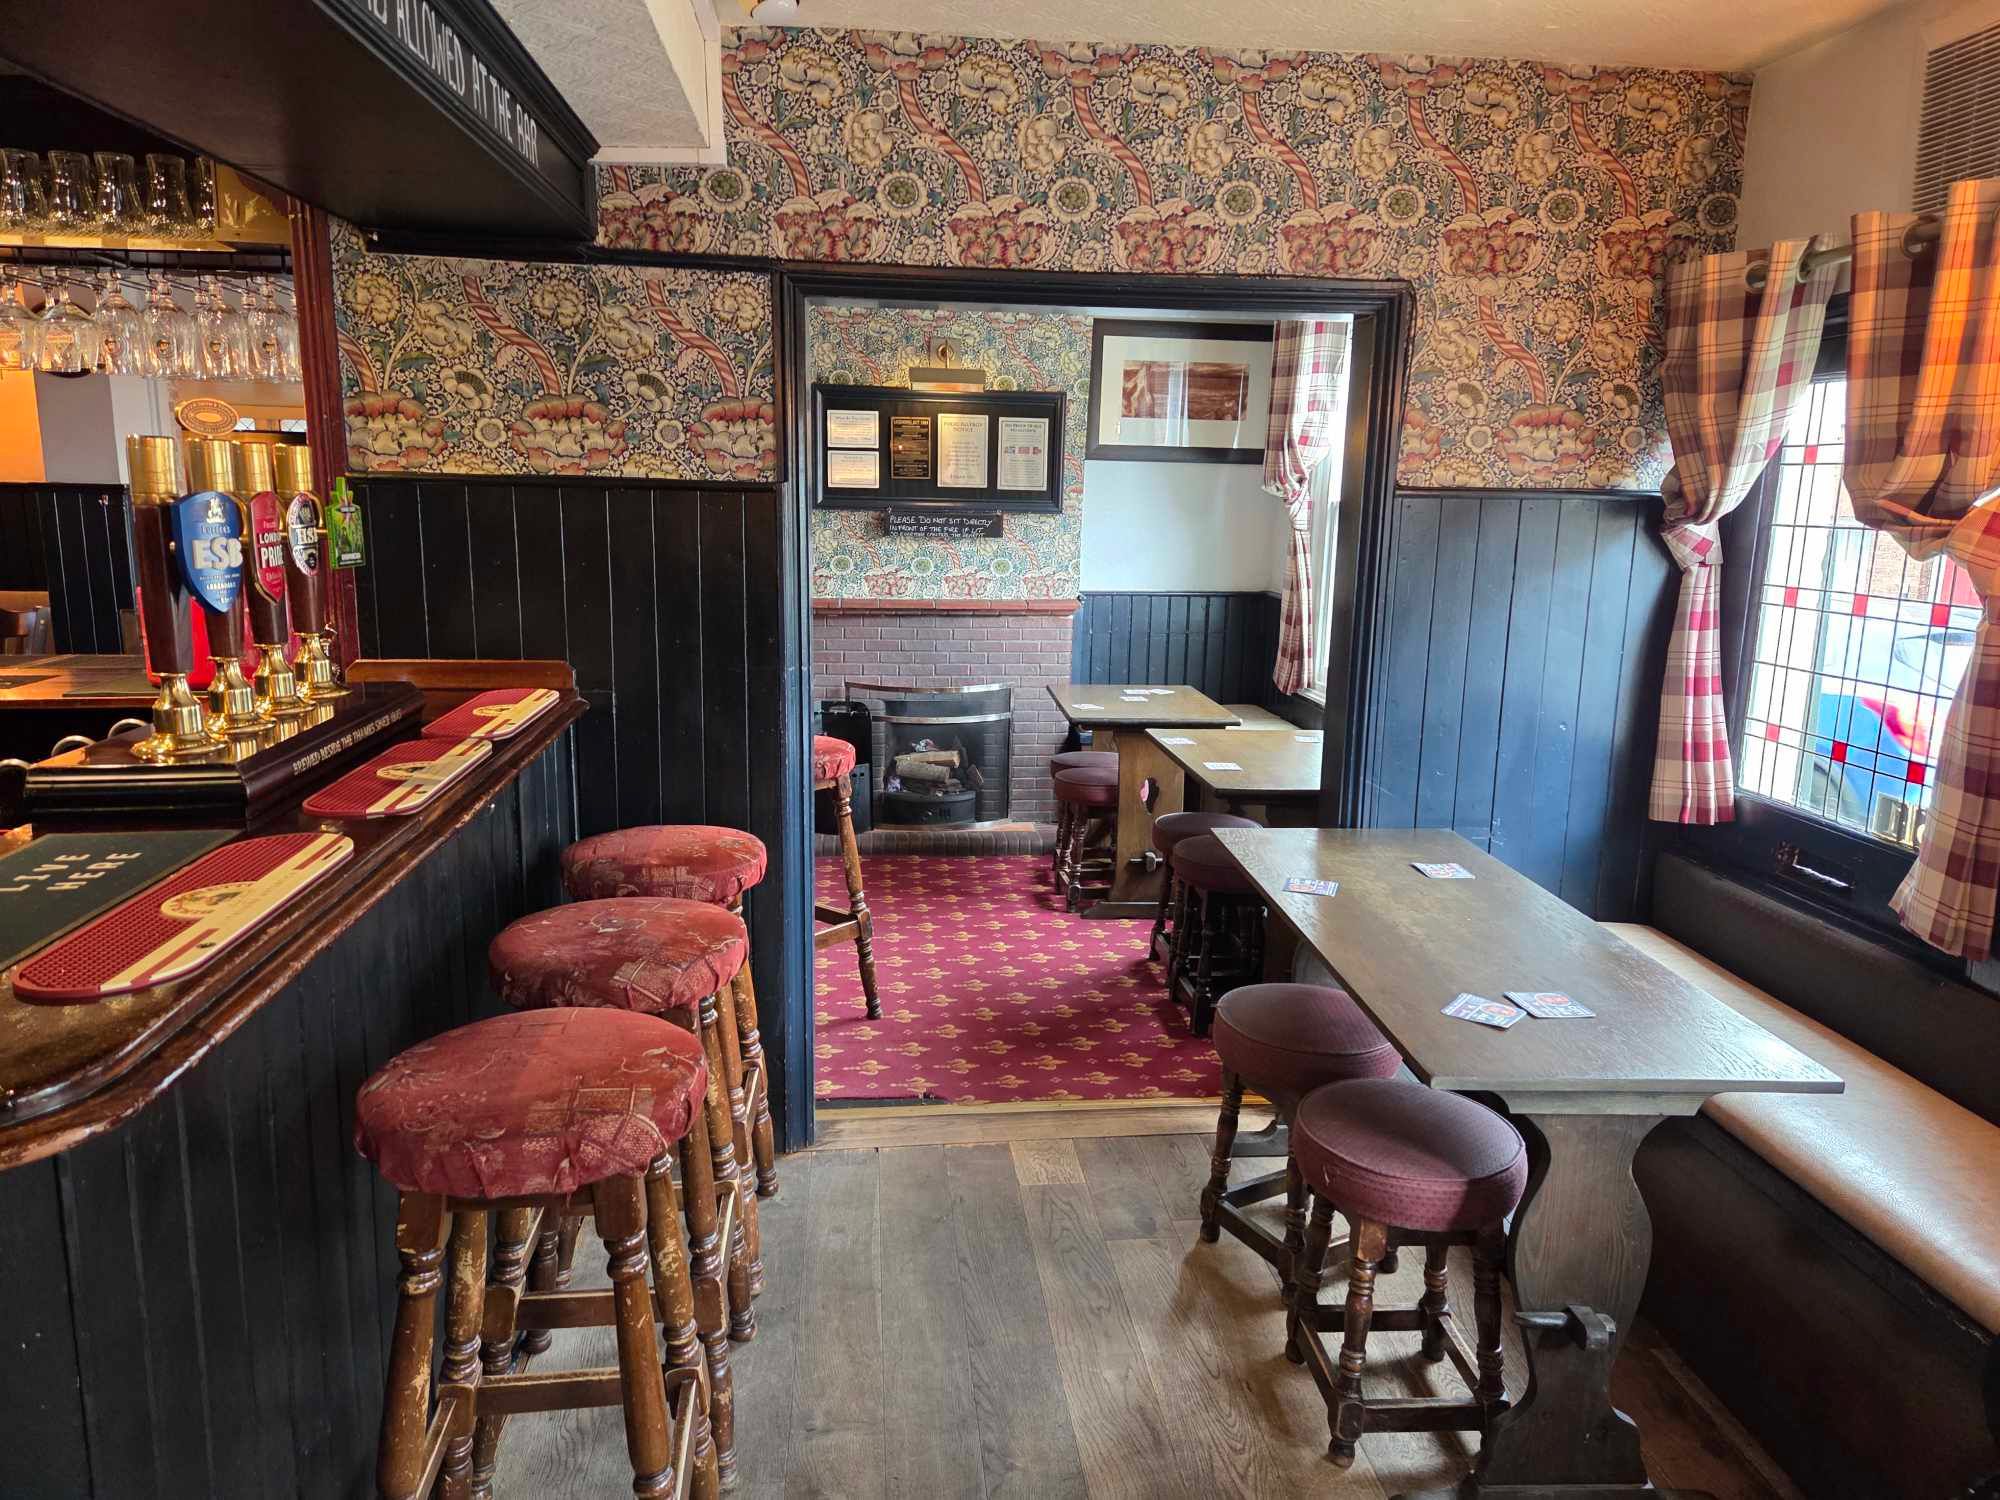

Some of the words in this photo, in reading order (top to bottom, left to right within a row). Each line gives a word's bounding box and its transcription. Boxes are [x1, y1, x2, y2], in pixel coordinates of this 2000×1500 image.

[397, 0, 465, 96] ALLOWED
[472, 54, 488, 119] AT
[489, 75, 512, 143] THE
[516, 103, 539, 168] BAR
[889, 515, 916, 524] PLEASE
[918, 516, 931, 524] DO
[932, 517, 946, 525] NOT
[192, 537, 243, 569] ESB
[292, 751, 321, 776] BREWED
[320, 741, 341, 760] BESIDE
[341, 734, 353, 749] THE
[353, 722, 376, 742] THAMES
[46, 852, 143, 891] HERE
